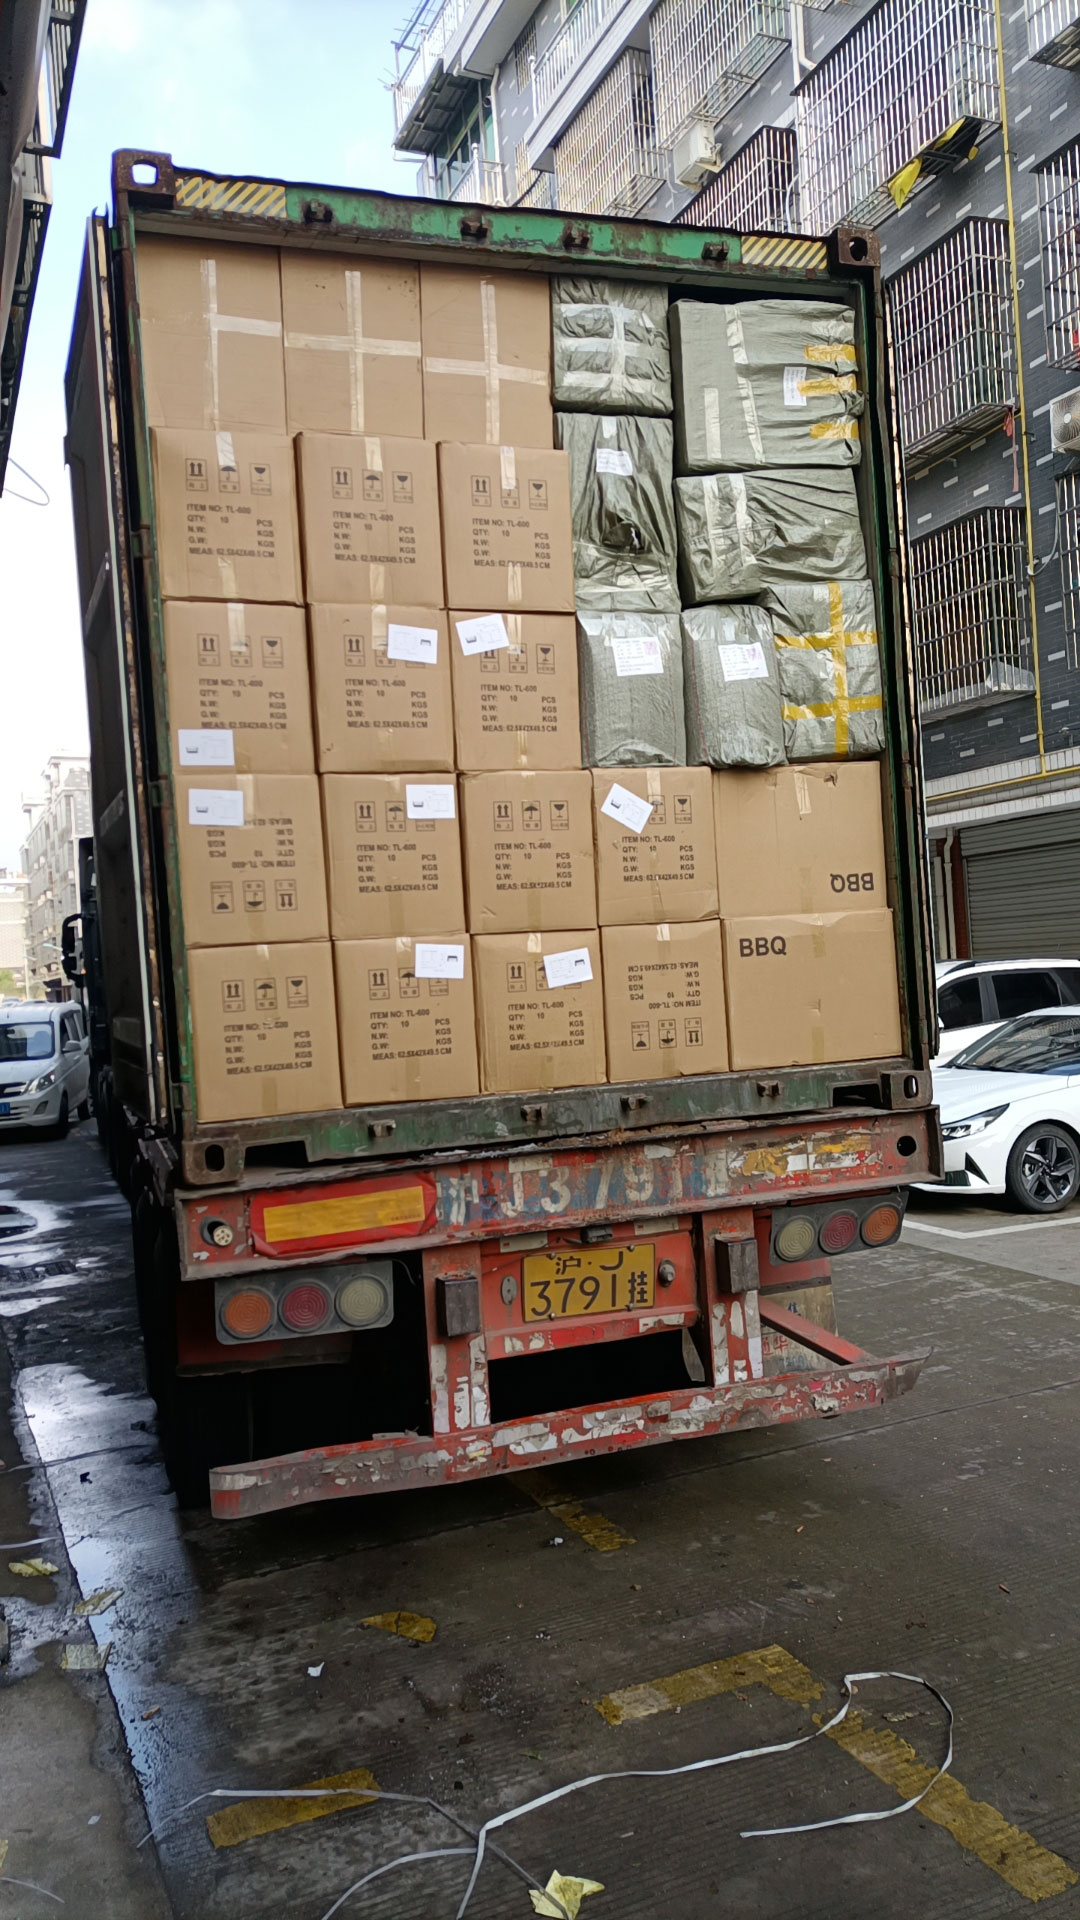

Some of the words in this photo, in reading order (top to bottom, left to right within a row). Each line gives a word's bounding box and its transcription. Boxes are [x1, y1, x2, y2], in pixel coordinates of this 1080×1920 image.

[186, 503, 206, 511] ITEM
[256, 519, 272, 527] PCS
[257, 529, 274, 537] KGS
[472, 528, 489, 536] QTY:
[399, 536, 415, 544] KGS
[399, 546, 415, 554] KGS
[494, 842, 511, 850] ITEM
[622, 845, 637, 853] QTY:
[357, 854, 374, 862] QTY:
[421, 863, 437, 871] KGS
[830, 872, 874, 893] BBQ
[739, 935, 787, 957] BBQ
[628, 983, 643, 991] KGS
[629, 992, 643, 1000] PCS
[685, 989, 700, 997] QTY:
[370, 1011, 388, 1019] ITEM
[508, 1013, 524, 1021] QTY:
[568, 1010, 582, 1018] PCS
[370, 1021, 388, 1030] QTY:
[569, 1019, 583, 1027] KGS
[435, 1027, 451, 1035] KGS
[435, 1037, 451, 1045] KGS
[530, 1271, 648, 1316] 3791挂
